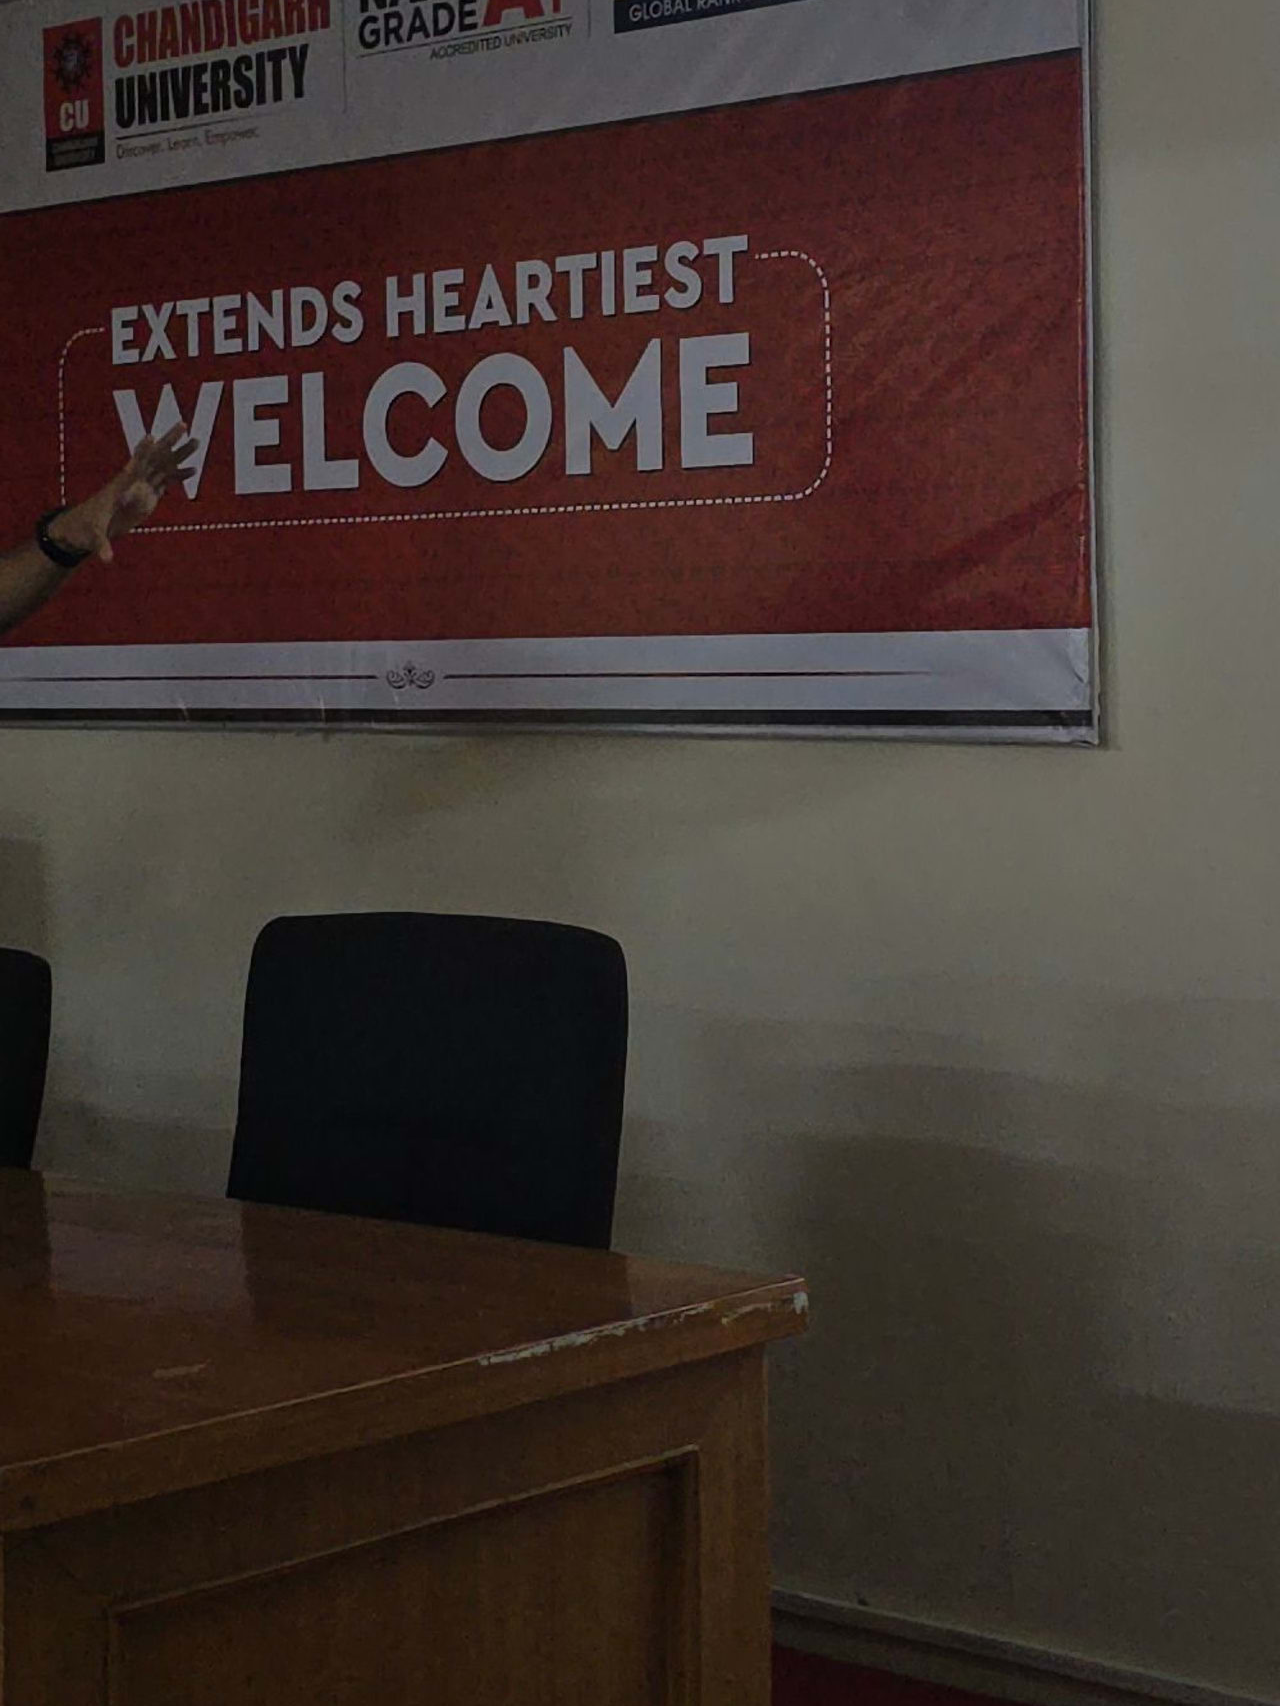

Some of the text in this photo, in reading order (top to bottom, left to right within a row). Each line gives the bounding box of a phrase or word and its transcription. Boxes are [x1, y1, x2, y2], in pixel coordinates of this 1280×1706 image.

[430, 23, 572, 60] ACCREDITED UNIVERSITY
[60, 99, 89, 131] CU
[115, 44, 308, 128] UNIVERSITY
[111, 235, 749, 366] EXTENDS HEARTIEST
[113, 332, 754, 500] WELCOME
